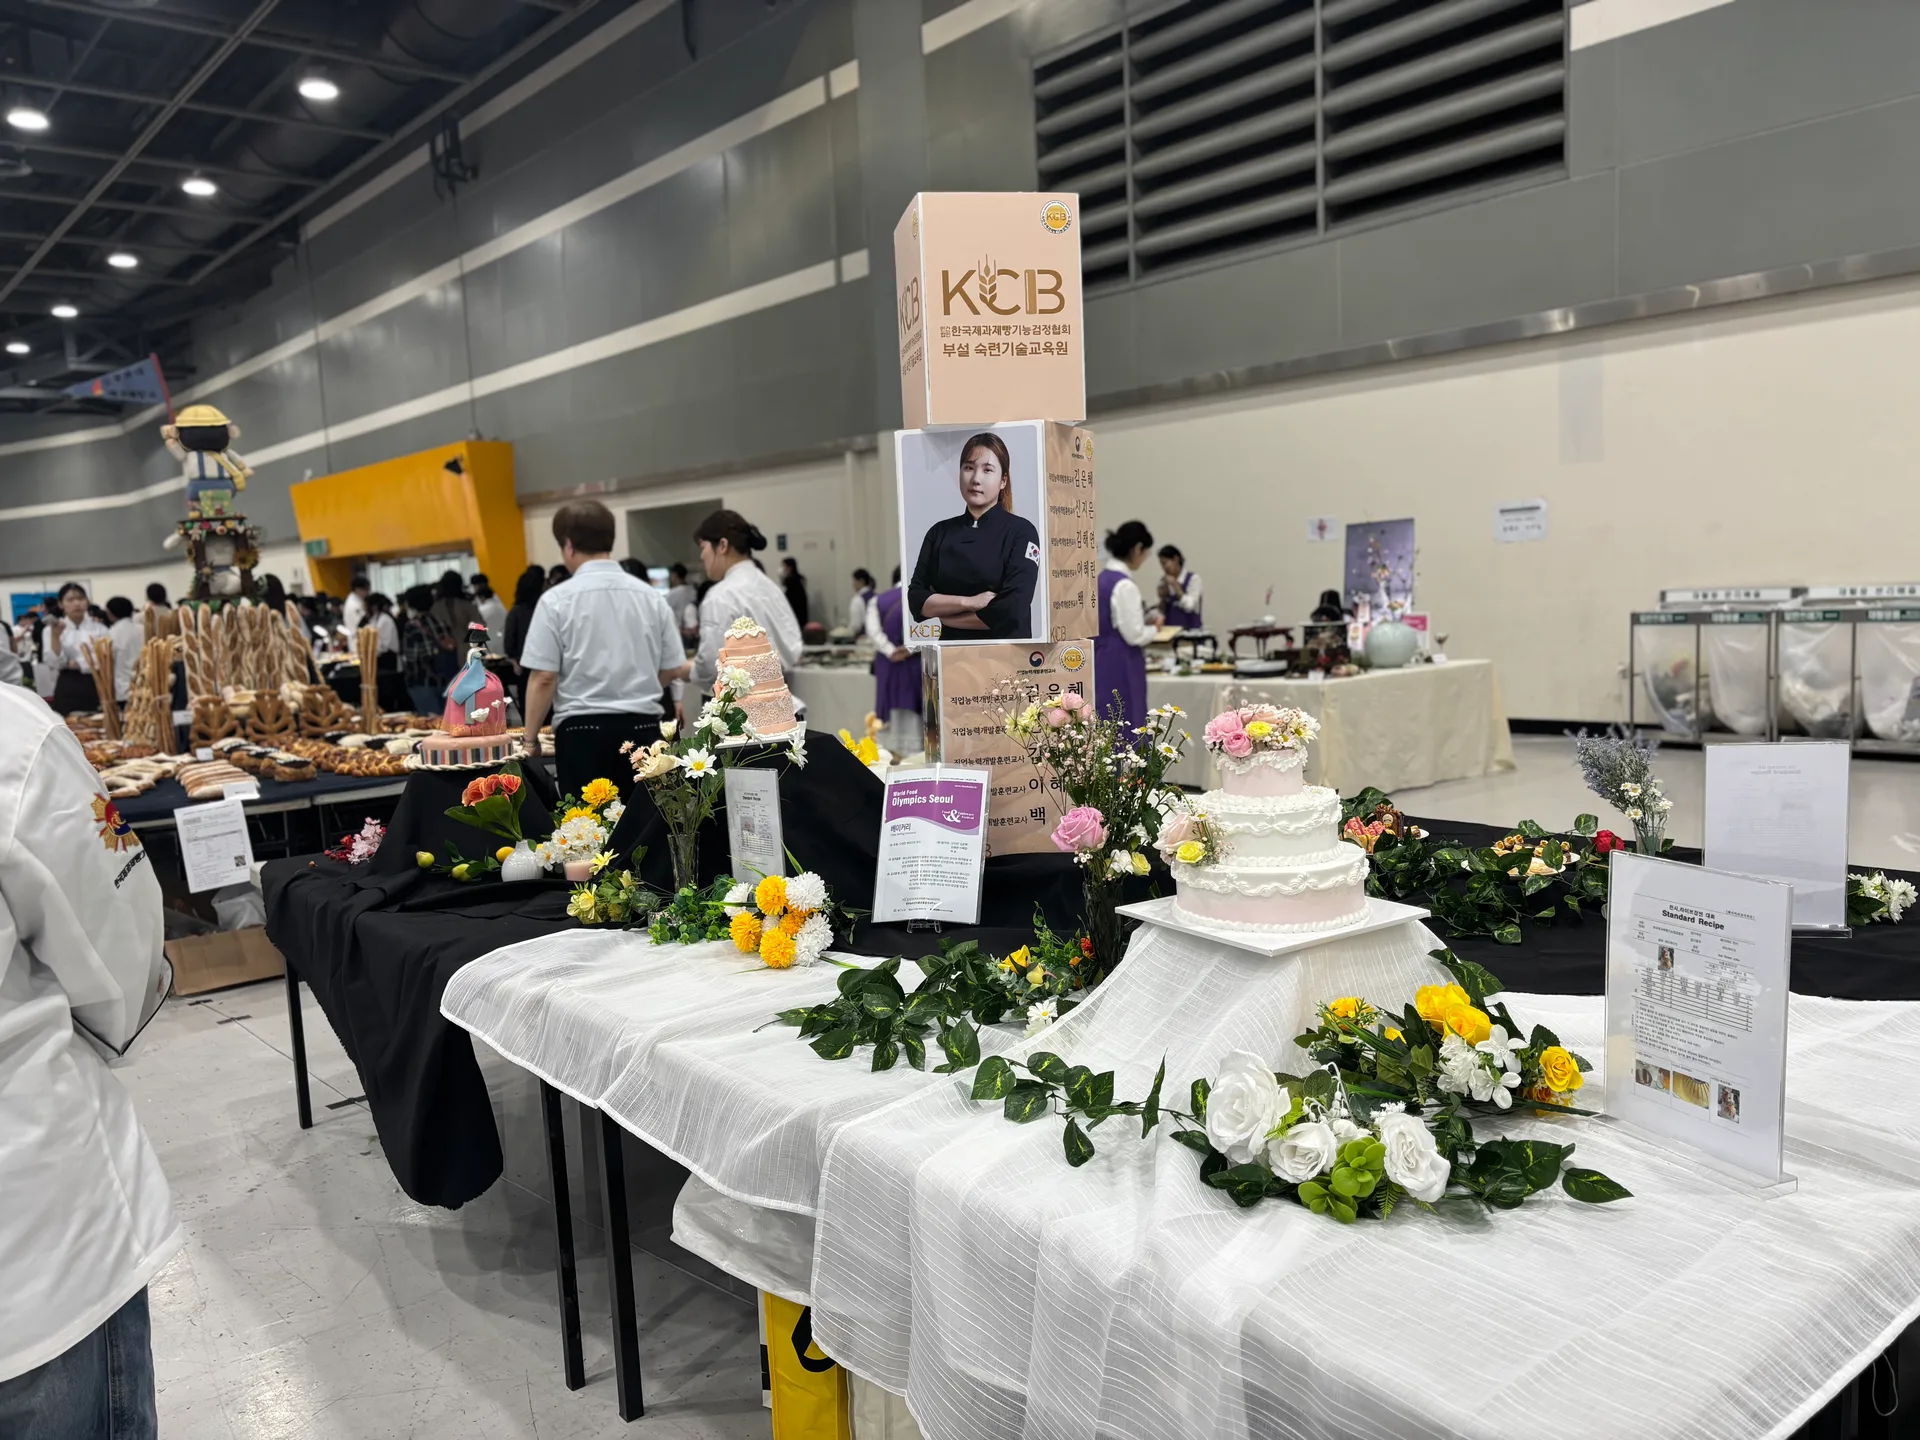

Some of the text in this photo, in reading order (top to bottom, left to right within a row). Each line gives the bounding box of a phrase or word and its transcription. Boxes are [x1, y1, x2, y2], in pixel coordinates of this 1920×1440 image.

[1046, 212, 1067, 221] KCB
[941, 268, 1066, 316] KCB
[898, 276, 920, 339] KCB
[951, 324, 1071, 337] 한국제과제빵기능검정협회
[942, 341, 1068, 358] 부설 숙련기술교육원
[1074, 468, 1093, 489] 김은혜
[1074, 499, 1094, 519] 신지은
[909, 625, 942, 639] KCB
[891, 794, 954, 808] Olympics Seoul
[890, 822, 911, 832] 베이커리
[1661, 909, 1725, 931] Standard Recipe
